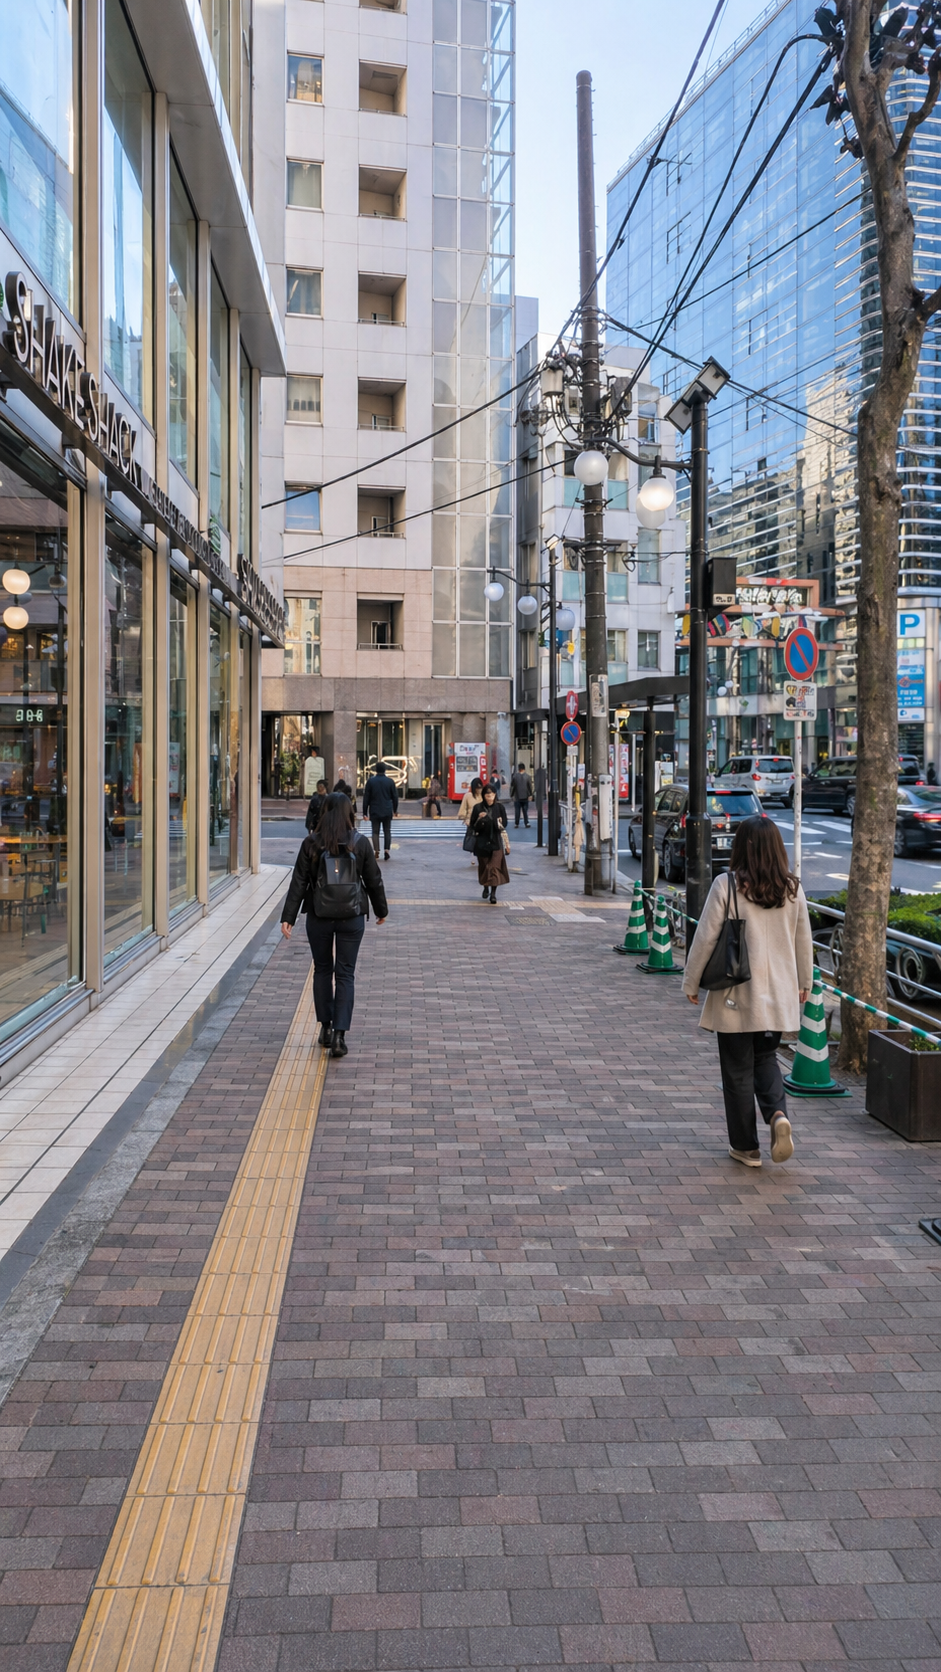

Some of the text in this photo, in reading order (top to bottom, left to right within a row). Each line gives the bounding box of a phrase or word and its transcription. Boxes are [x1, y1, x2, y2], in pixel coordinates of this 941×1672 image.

[3, 271, 138, 487] SHAKE SHACK
[900, 614, 920, 635] P
